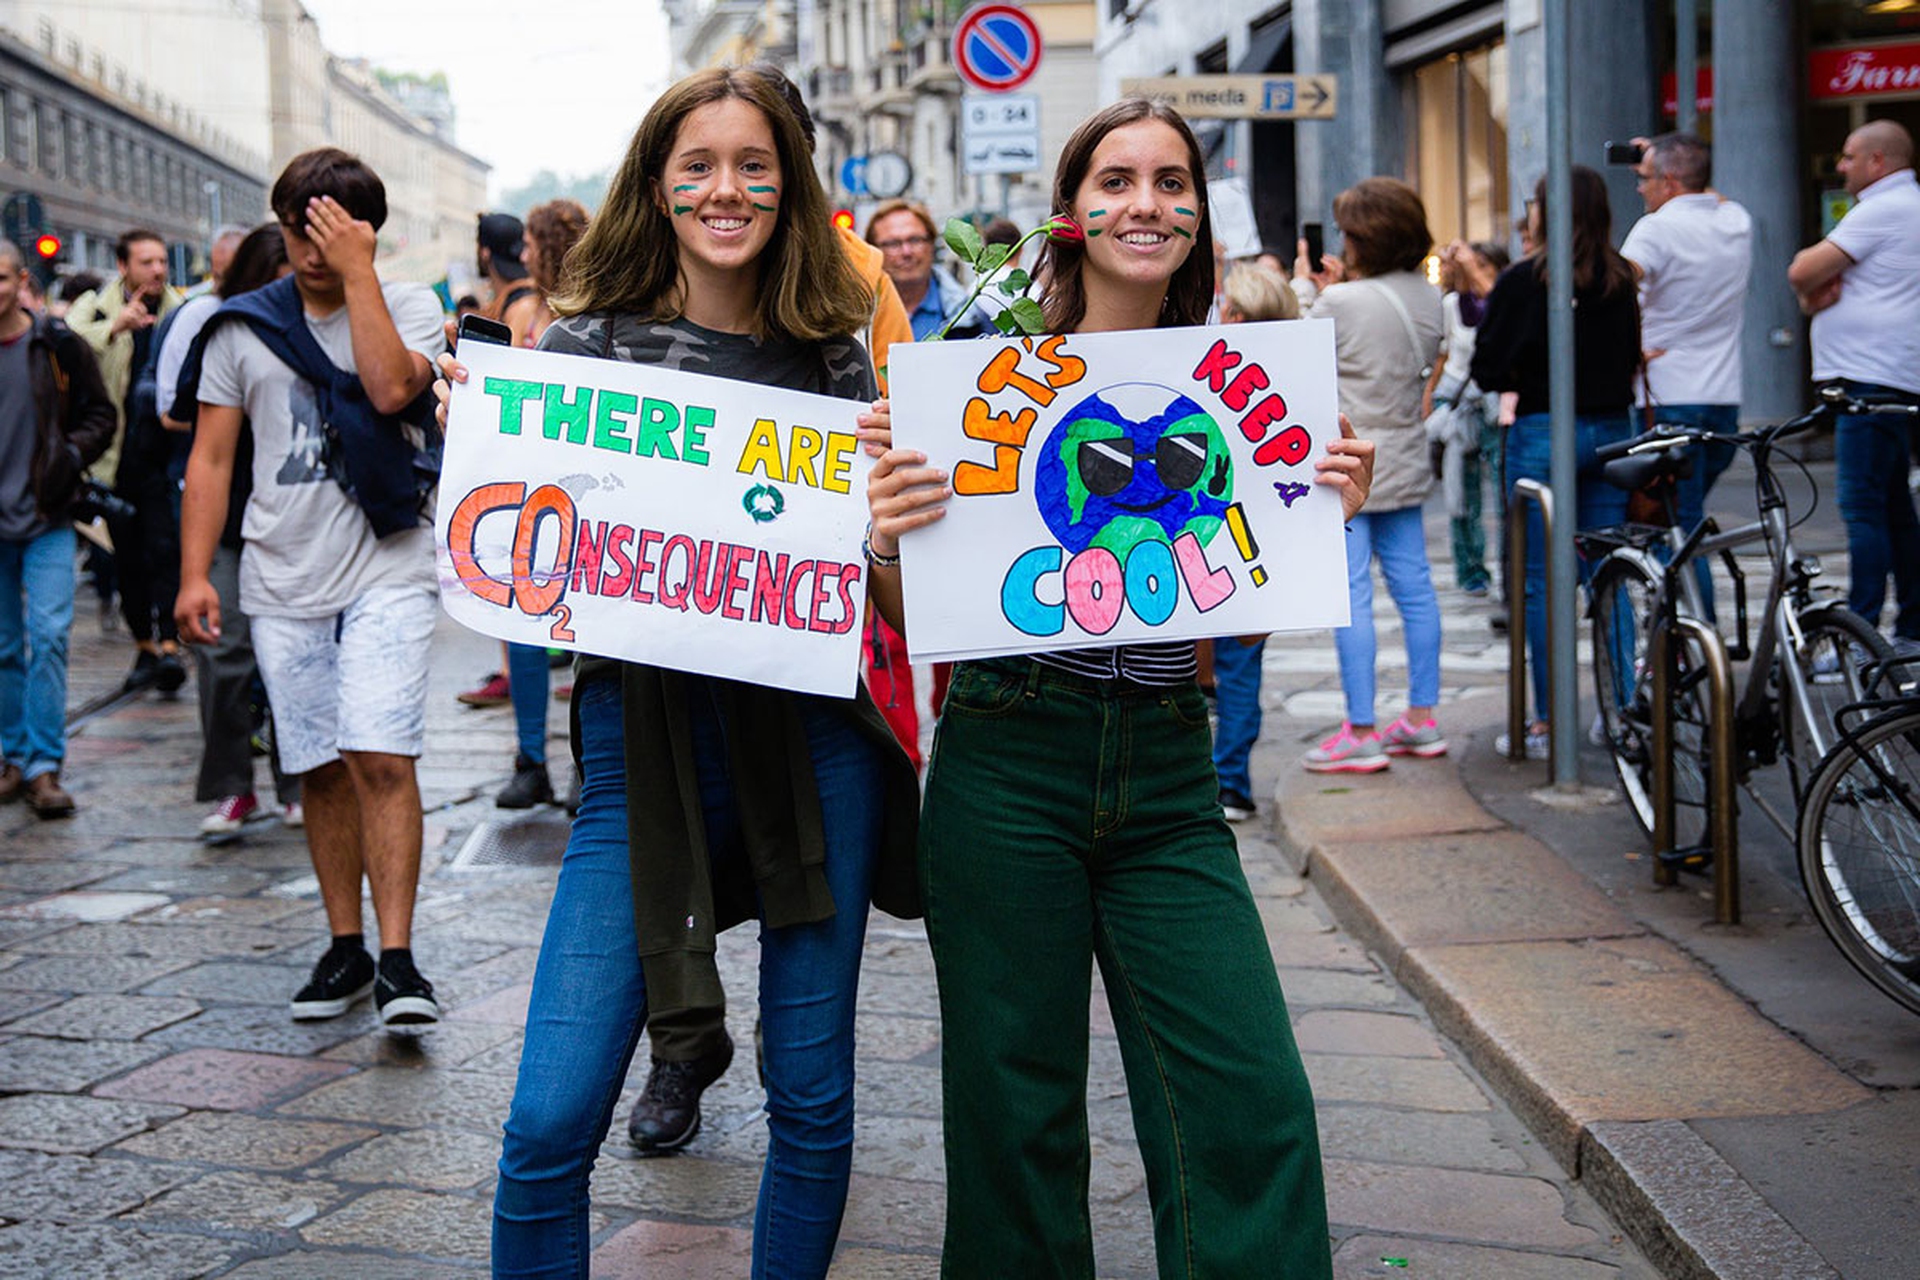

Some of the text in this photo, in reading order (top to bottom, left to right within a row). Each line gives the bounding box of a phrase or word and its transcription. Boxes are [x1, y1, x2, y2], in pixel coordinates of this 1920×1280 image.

[1186, 88, 1245, 104] meda
[484, 376, 858, 494] THERE ARE
[953, 334, 1087, 496] LET'S
[1193, 338, 1312, 467] KEEP
[447, 481, 861, 634] CONSEQUENCES
